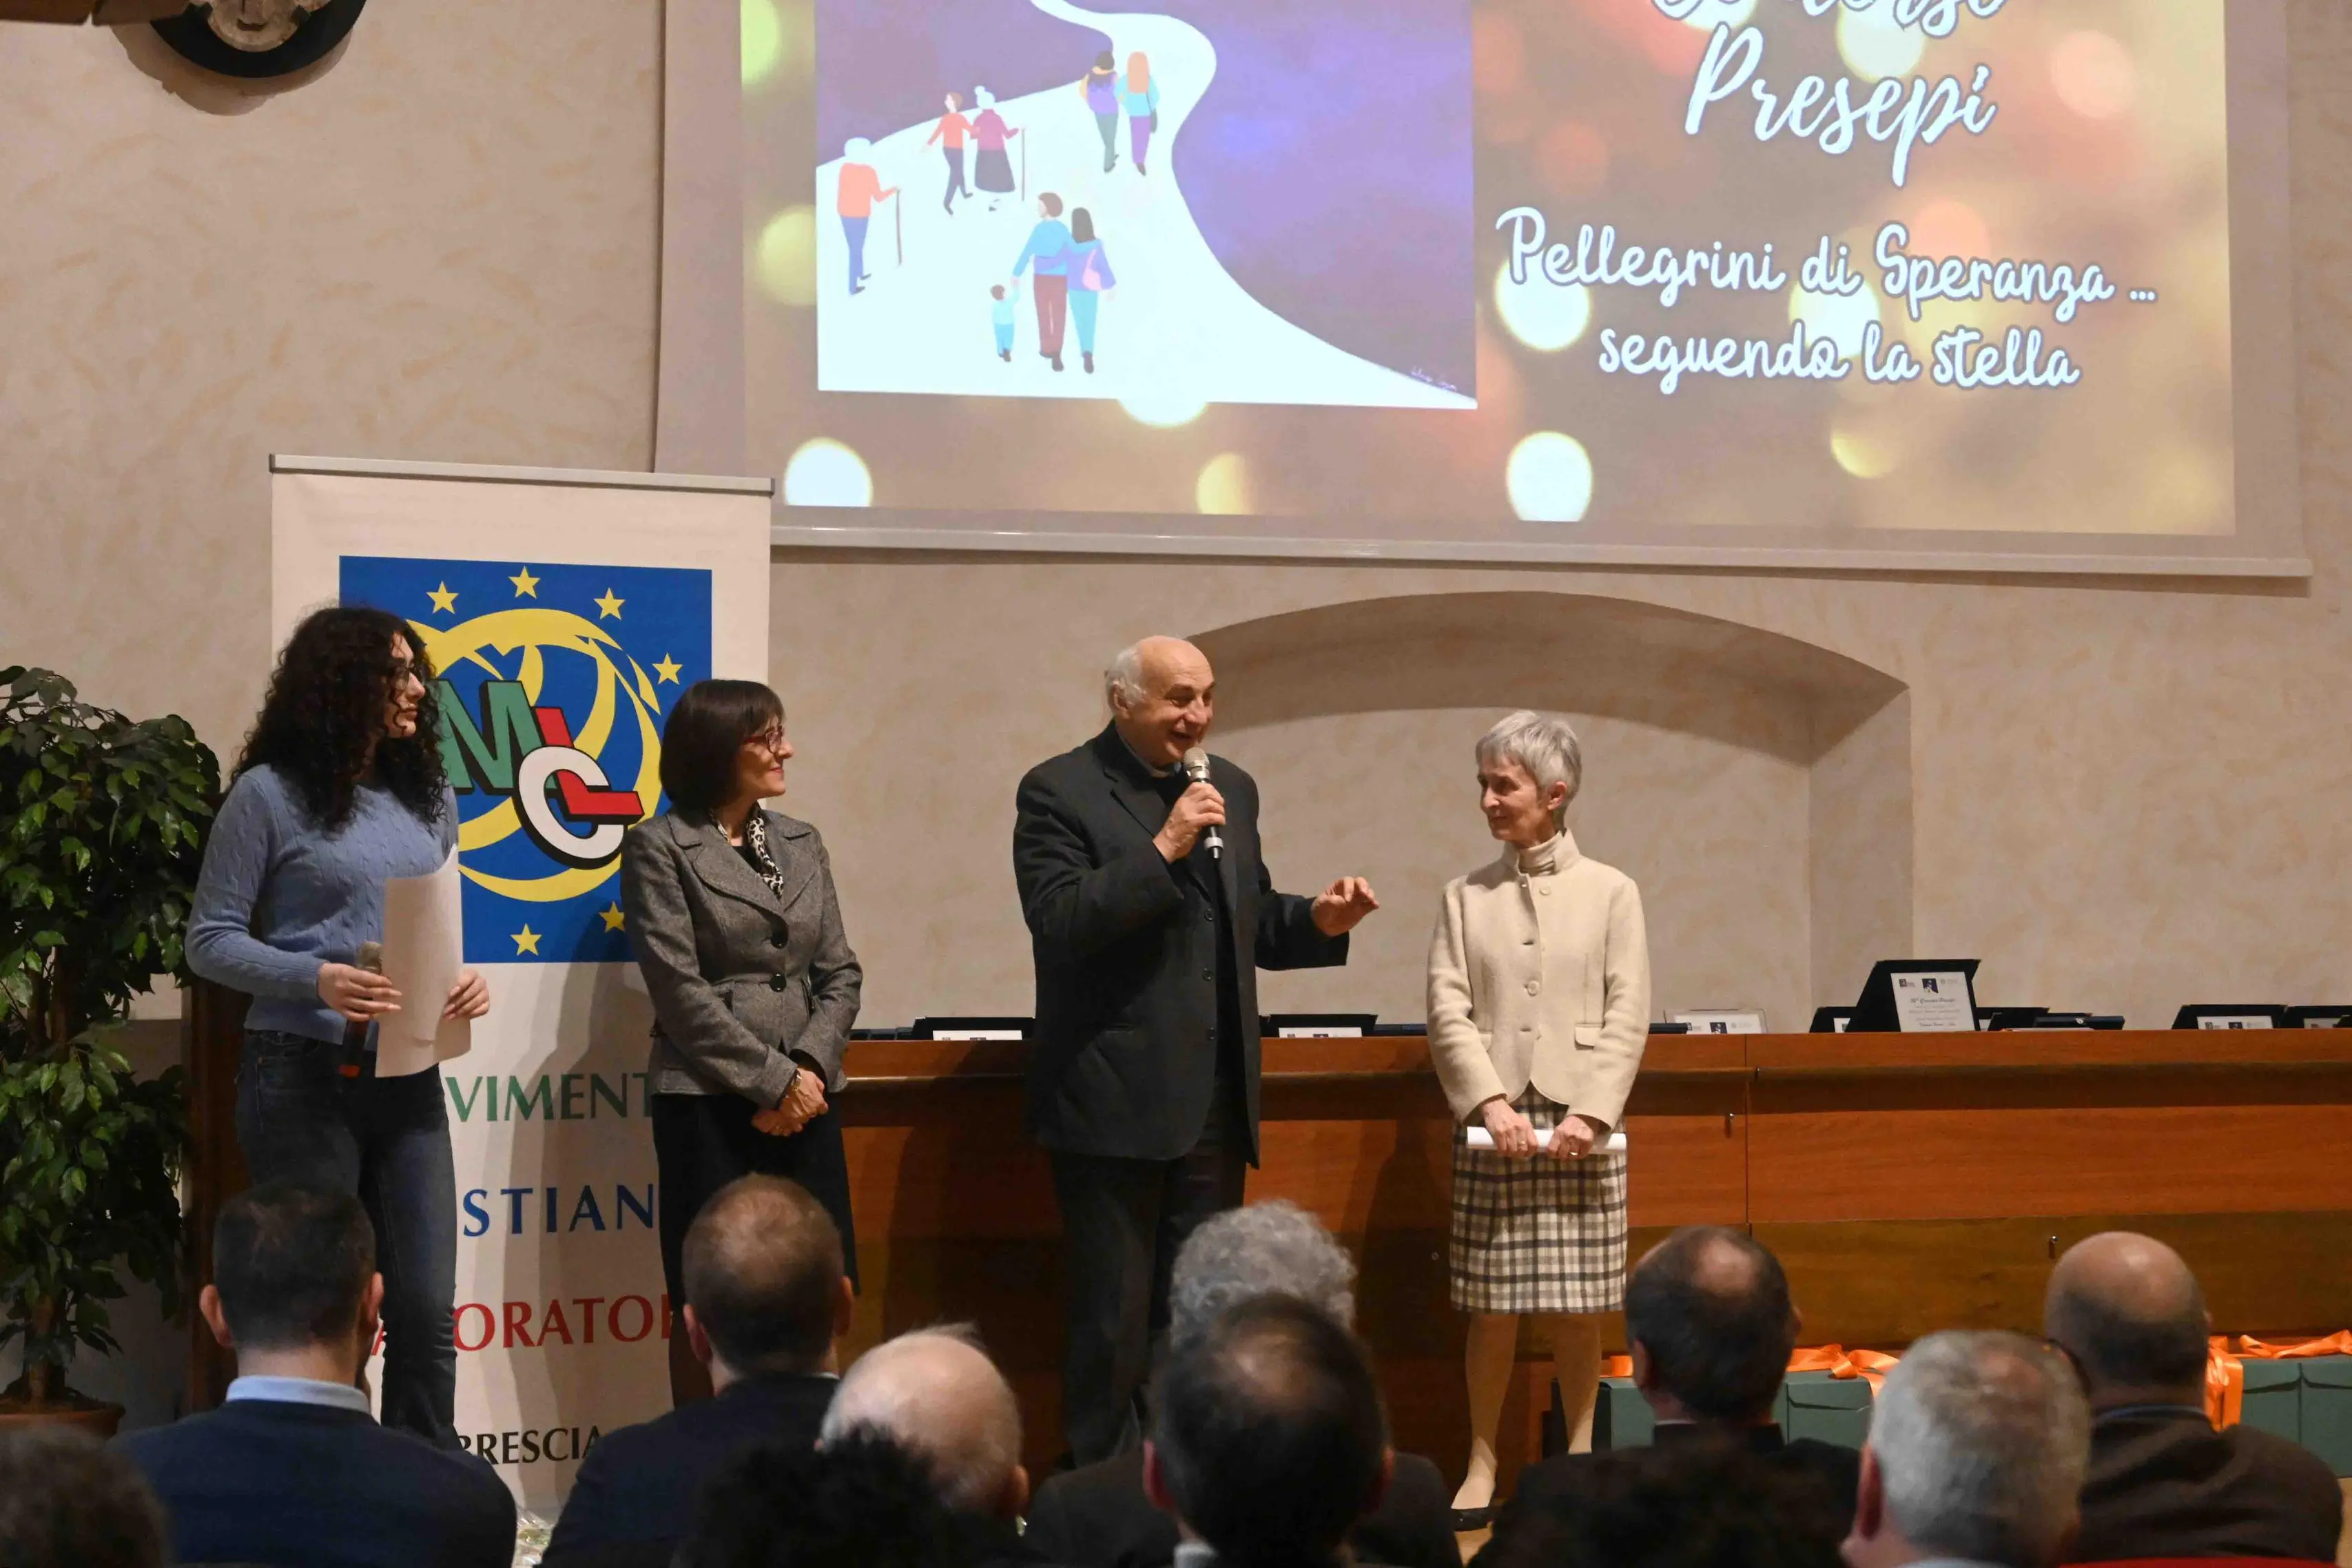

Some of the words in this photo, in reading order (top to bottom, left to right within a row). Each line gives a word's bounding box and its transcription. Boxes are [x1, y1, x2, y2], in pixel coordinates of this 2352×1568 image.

[1684, 22, 1999, 187] Presepi
[1495, 207, 1786, 307] Pellegrini
[1801, 236, 1863, 296] di
[1876, 223, 2114, 321] Speranza
[1600, 322, 1849, 393] seguendo
[1861, 324, 1920, 382] la
[1932, 327, 2080, 386] stella
[452, 1293, 671, 1352] ORATO
